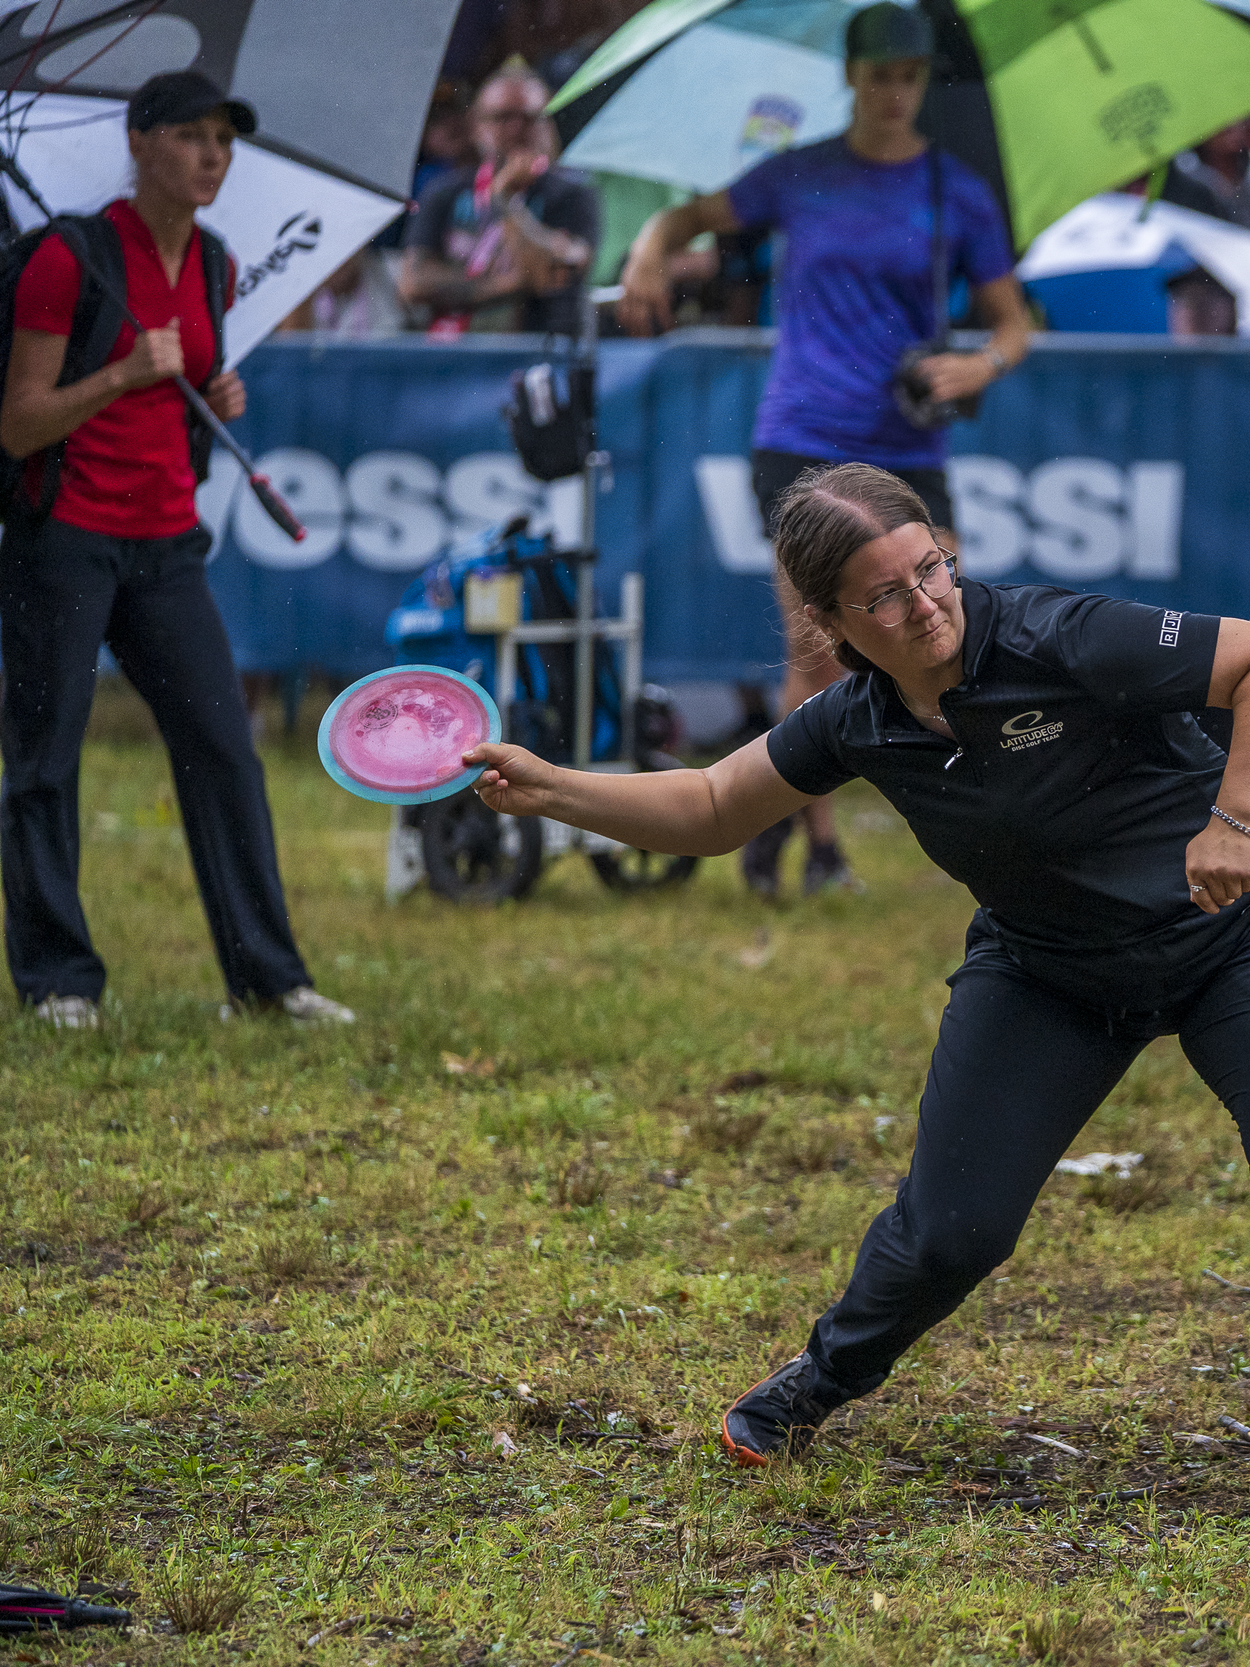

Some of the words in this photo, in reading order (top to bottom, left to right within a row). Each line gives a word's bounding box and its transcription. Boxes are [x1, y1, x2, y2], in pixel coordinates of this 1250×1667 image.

[694, 454, 1186, 581] vssi
[1011, 744, 1026, 752] DISC
[1026, 739, 1041, 748] GOLF
[1042, 733, 1060, 743] TEAM
